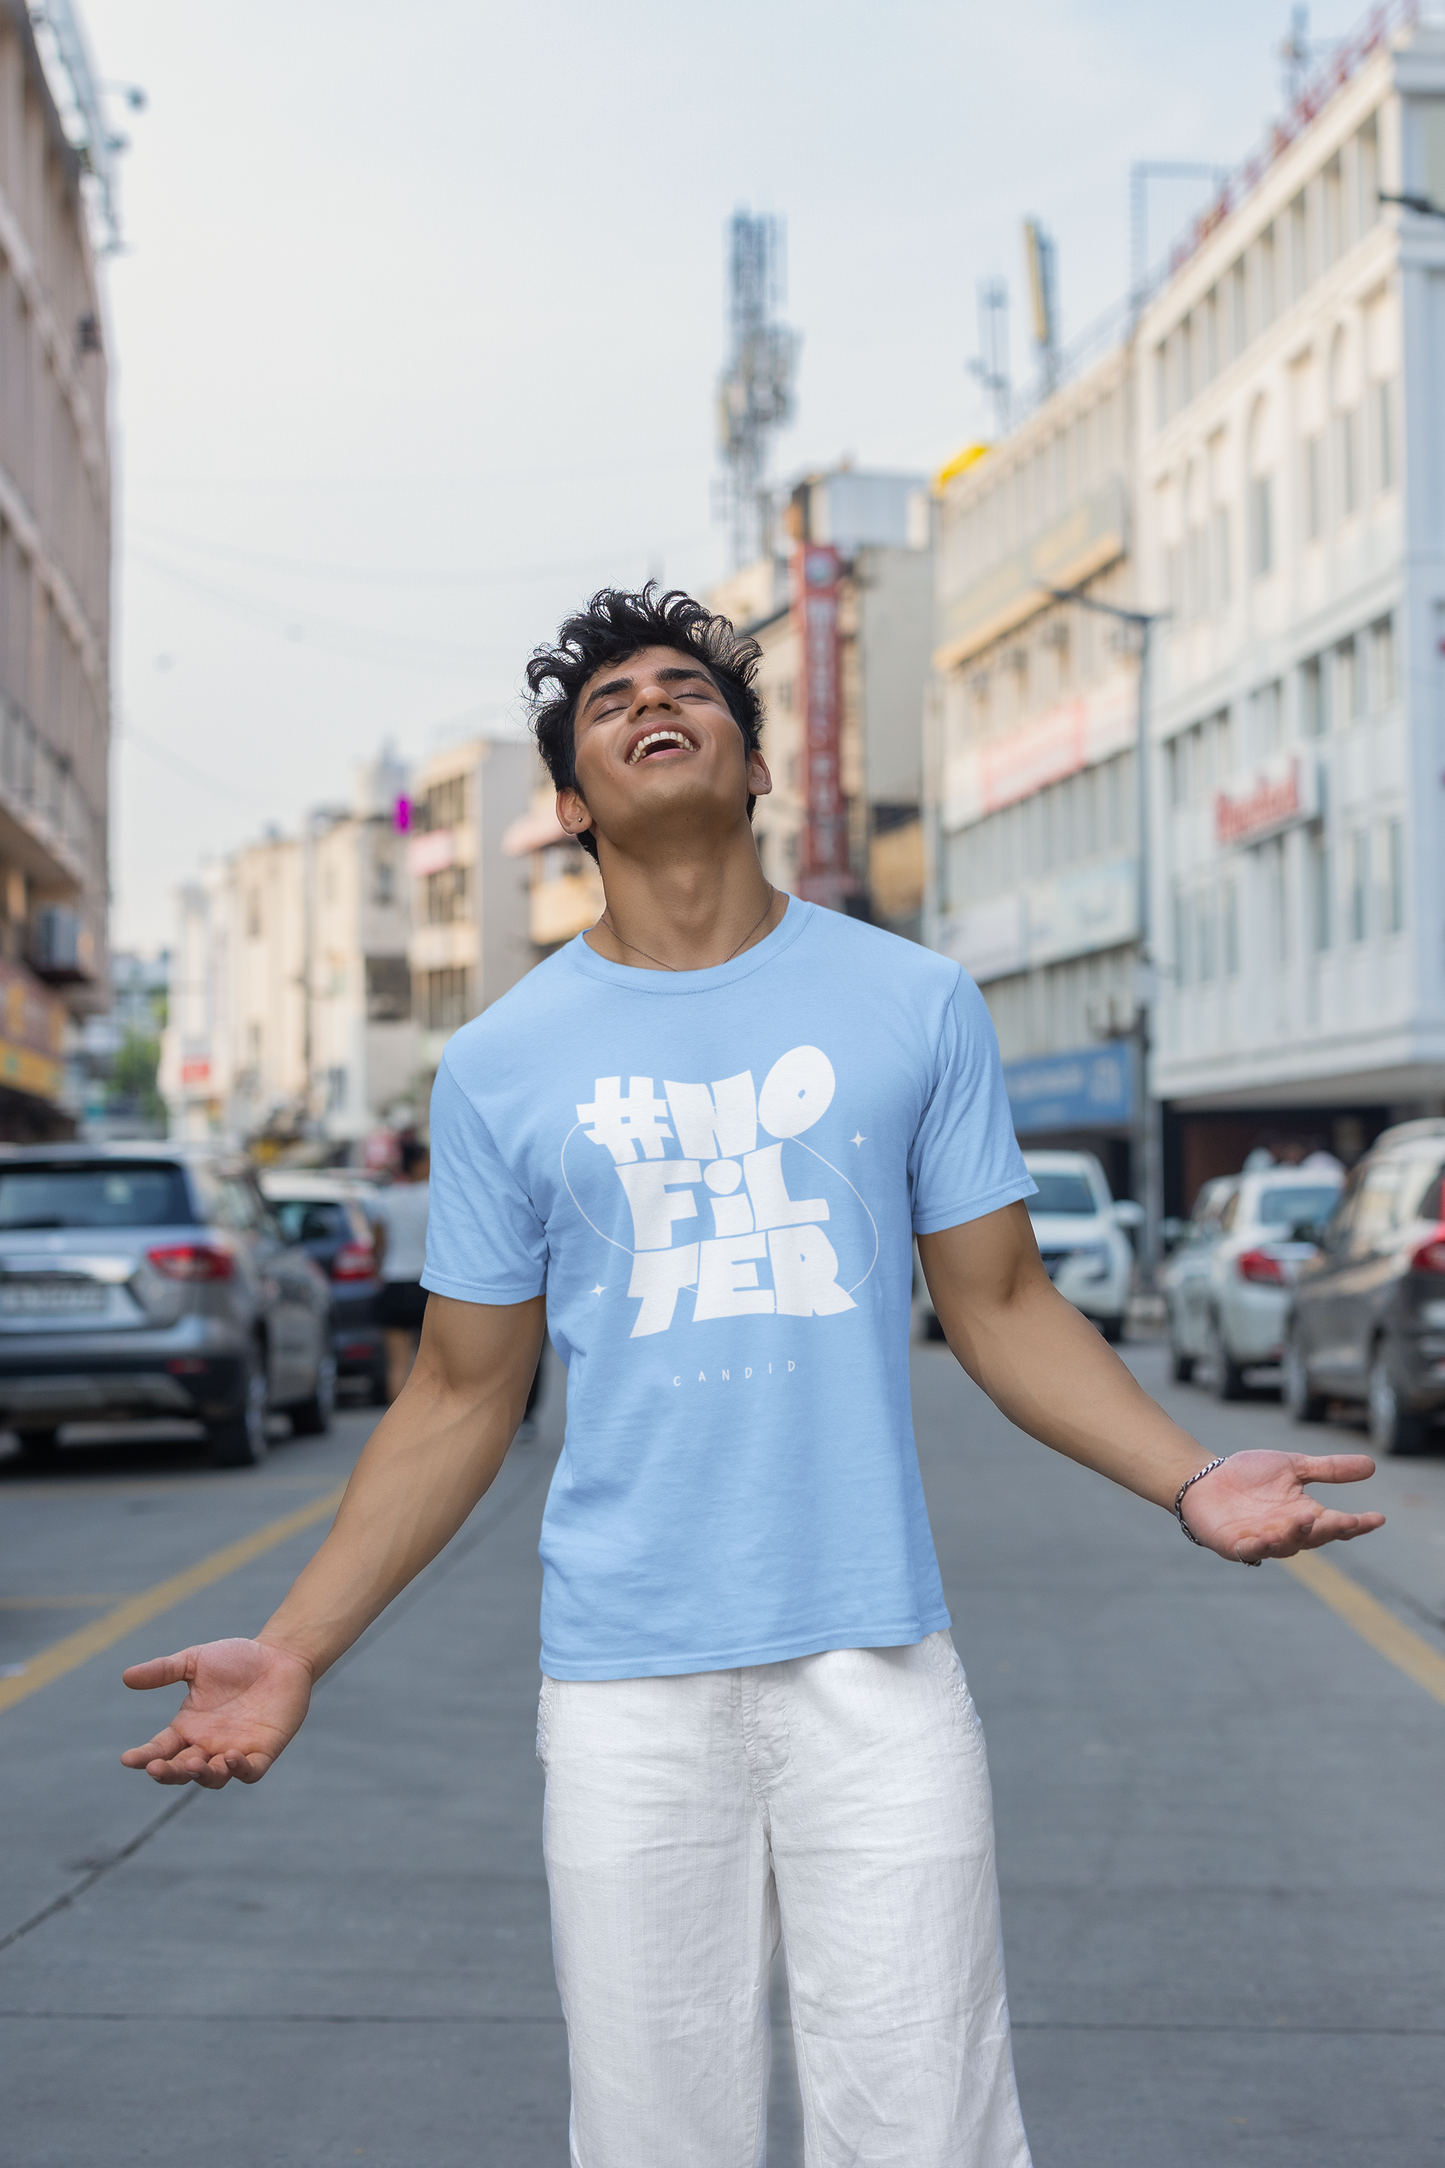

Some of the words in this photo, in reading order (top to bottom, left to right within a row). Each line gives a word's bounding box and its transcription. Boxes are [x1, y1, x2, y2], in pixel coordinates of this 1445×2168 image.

[575, 1045, 836, 1165] #NO
[627, 1224, 859, 1339] TER
[673, 1360, 796, 1387] CANDID
